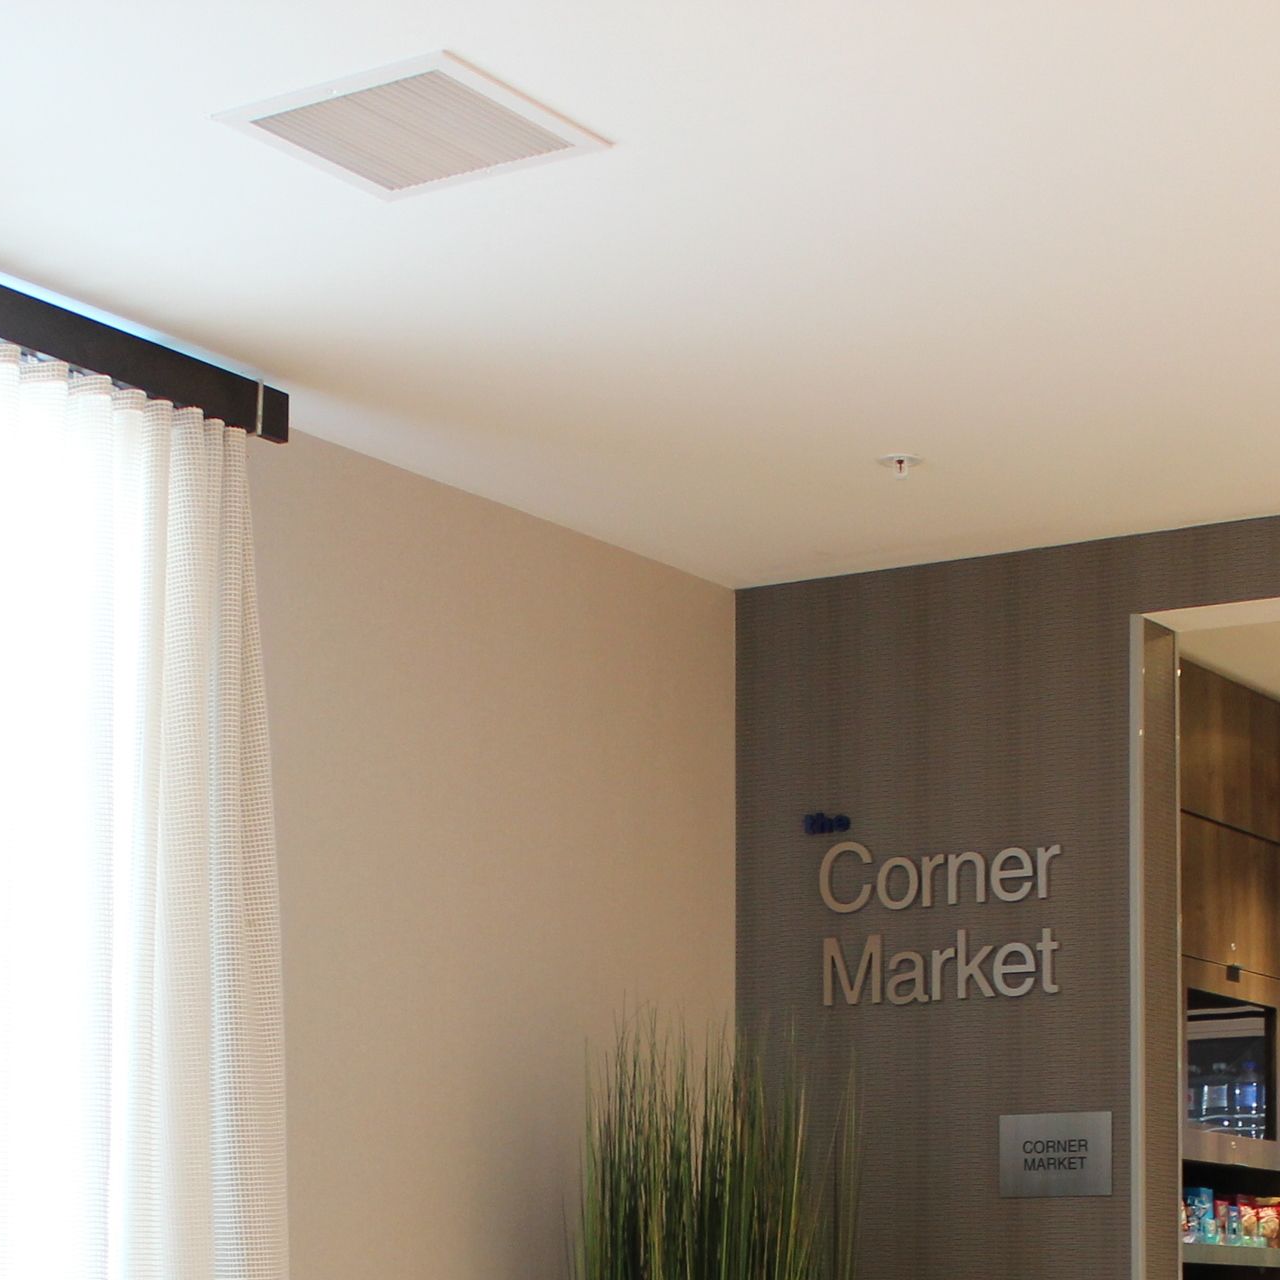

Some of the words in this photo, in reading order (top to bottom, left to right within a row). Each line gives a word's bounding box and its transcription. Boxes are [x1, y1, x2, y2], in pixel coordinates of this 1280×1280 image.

[819, 841, 1062, 914] Corner
[822, 928, 1061, 1007] Market
[1022, 1139, 1088, 1154] CORNER
[1023, 1156, 1087, 1171] MARKET
